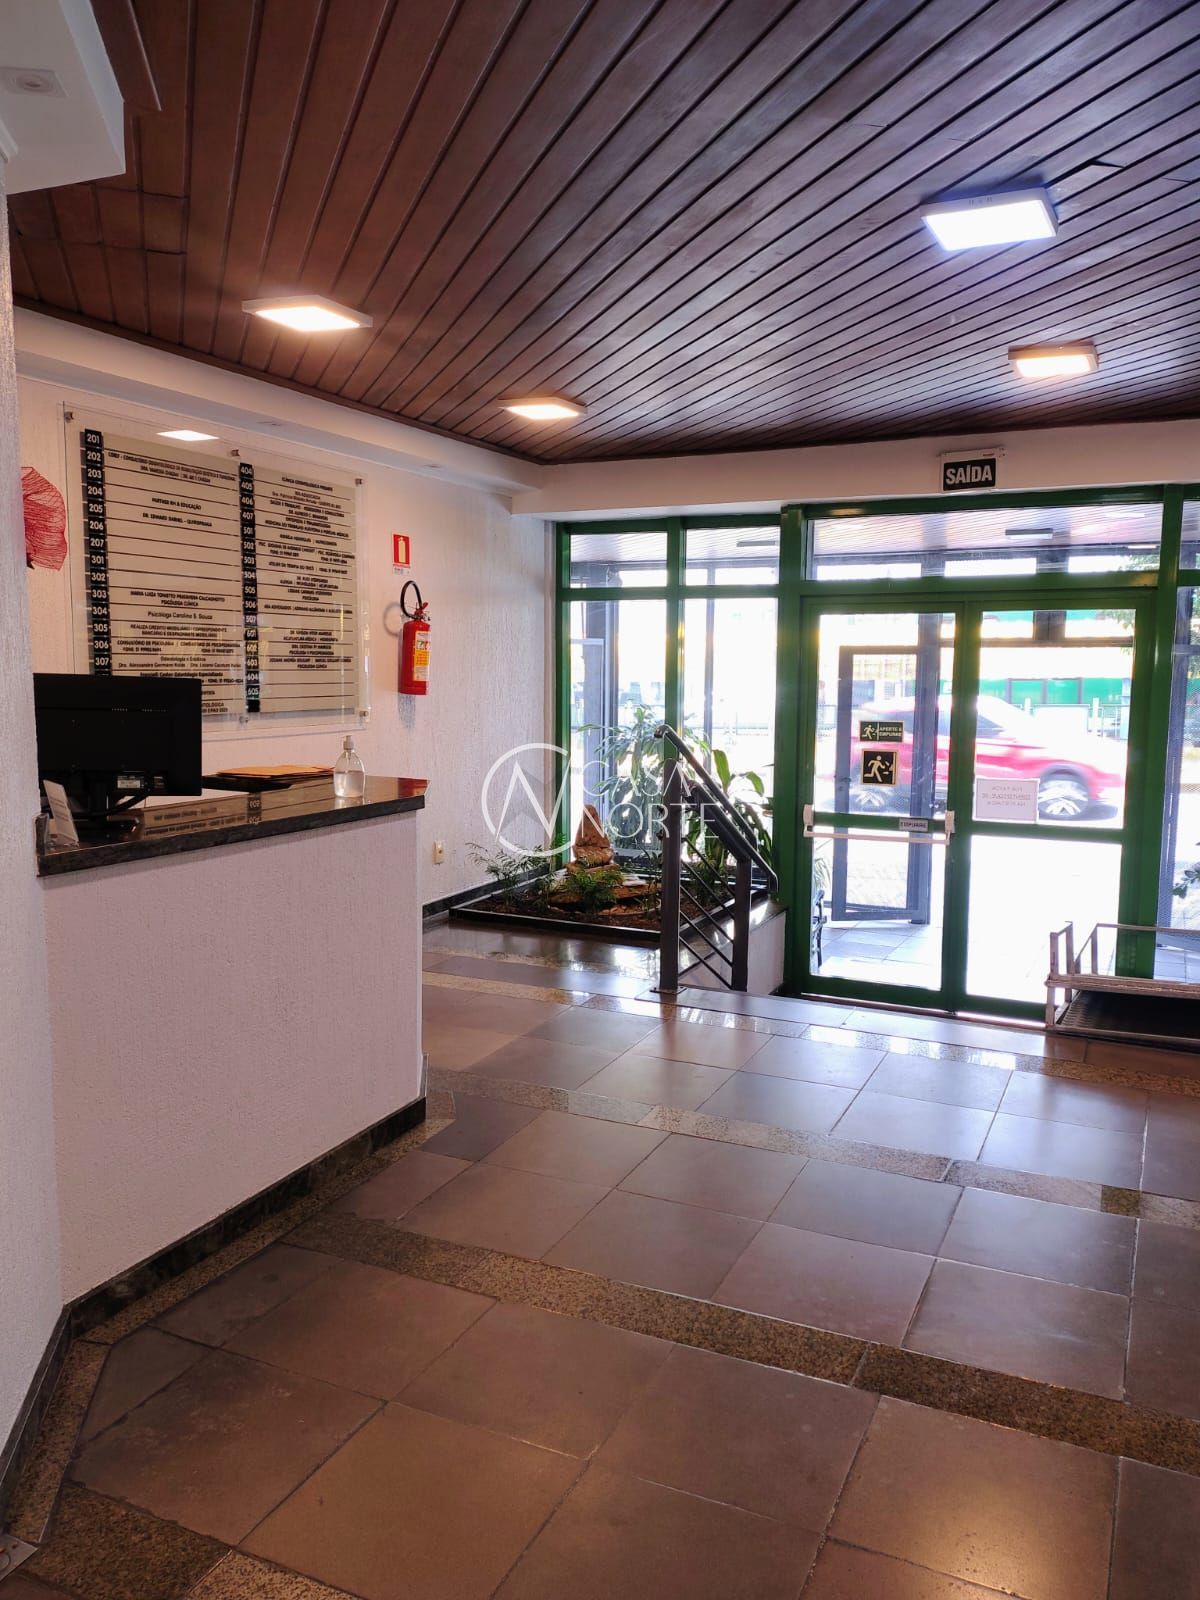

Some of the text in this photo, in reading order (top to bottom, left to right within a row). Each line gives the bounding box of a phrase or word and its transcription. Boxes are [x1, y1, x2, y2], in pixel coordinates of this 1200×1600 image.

[87, 434, 100, 442] 201
[87, 452, 100, 460] 202
[88, 469, 102, 478] 203
[946, 464, 992, 485] SAÍDA
[241, 482, 253, 490] 405
[88, 486, 102, 495] 204
[242, 496, 253, 504] 406
[89, 504, 103, 512] 205
[242, 511, 253, 519] 407
[90, 521, 103, 530] 206
[90, 538, 104, 547] 207
[91, 555, 104, 564] 301
[92, 572, 106, 581] 302
[92, 590, 106, 598] 303
[92, 607, 107, 615] 304
[94, 623, 108, 632] 305
[94, 640, 108, 649] 306
[96, 658, 109, 666] 307
